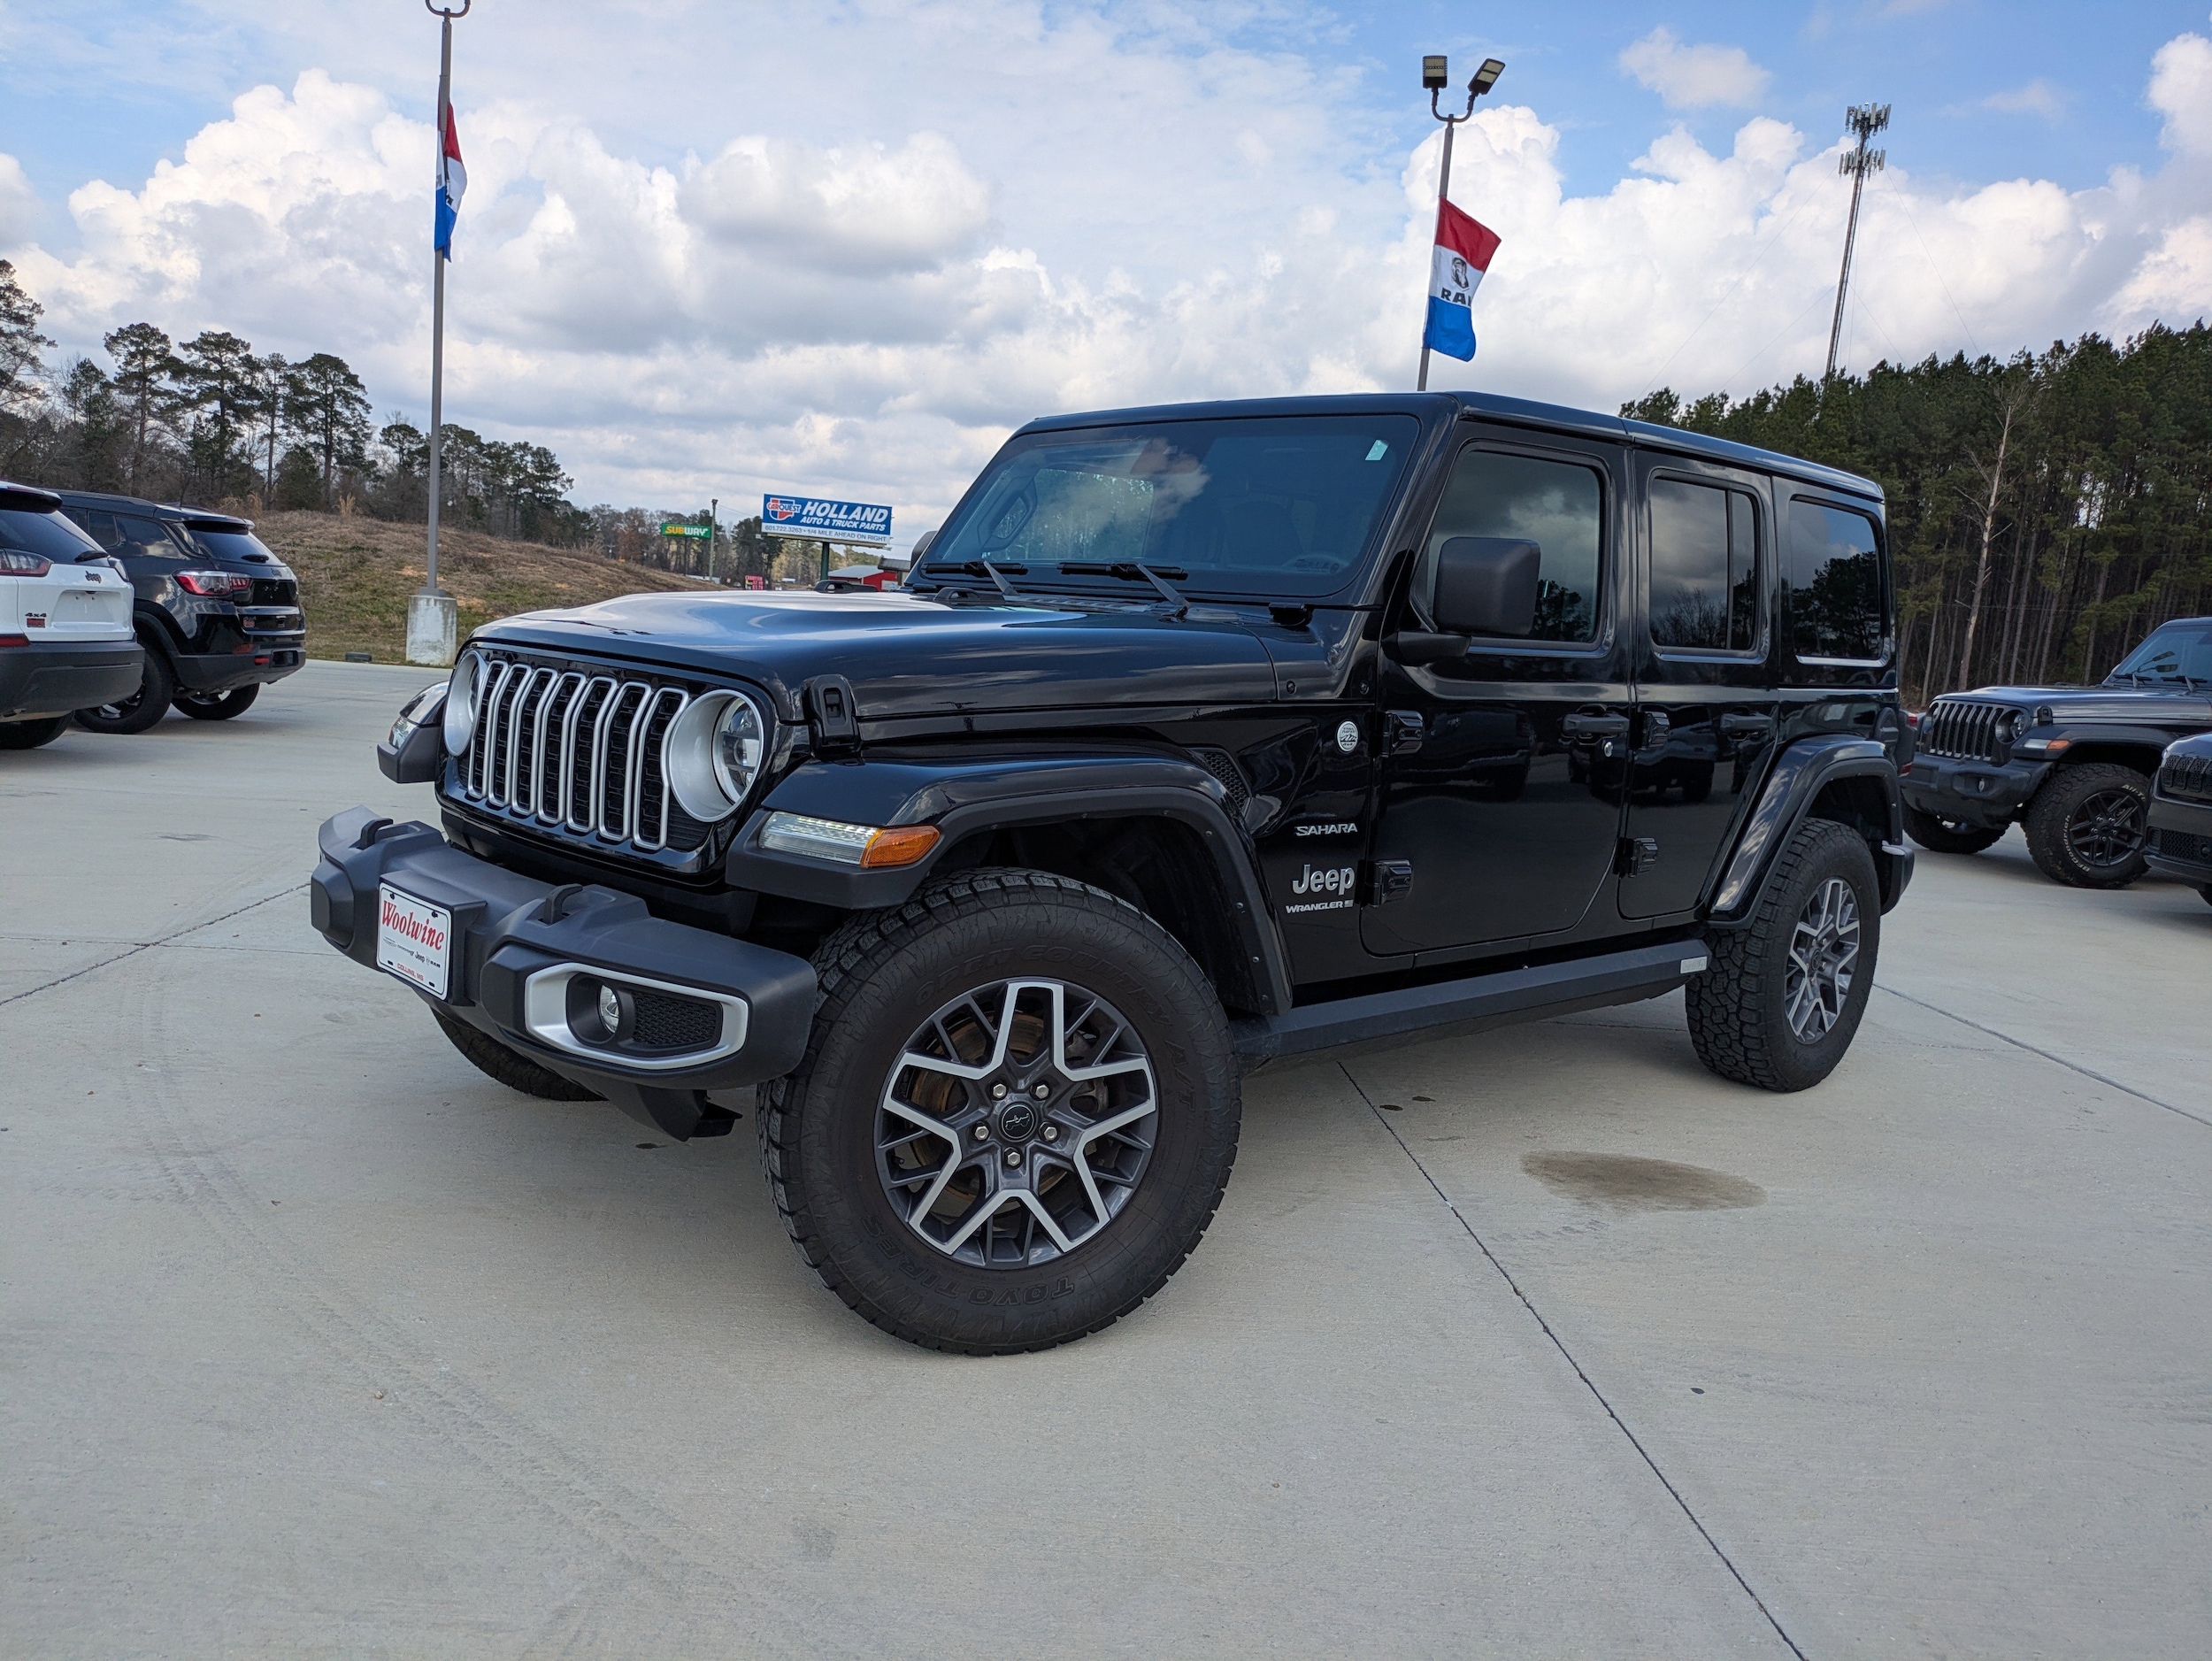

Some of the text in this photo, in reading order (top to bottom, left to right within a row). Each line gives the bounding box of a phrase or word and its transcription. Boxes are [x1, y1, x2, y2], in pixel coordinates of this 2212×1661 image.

[767, 502, 801, 512] CARQUEST
[802, 501, 888, 523] HOLLAND
[665, 526, 709, 536] SUBWAY
[800, 516, 824, 525] AUTO
[832, 519, 859, 529] TRUCK
[859, 522, 887, 532] PARTS
[85, 570, 102, 584] Jeep
[1294, 823, 1358, 836] SAHARA
[2062, 814, 2091, 873] BFGoodrich
[1292, 864, 1355, 895] Jeep
[1286, 900, 1344, 913] WRANGLER
[382, 900, 445, 950] Woolwine
[915, 947, 1015, 1006] OPEN
[1020, 943, 1175, 1027] COUNTRY
[859, 1216, 1076, 1308] TOYO TIRES
